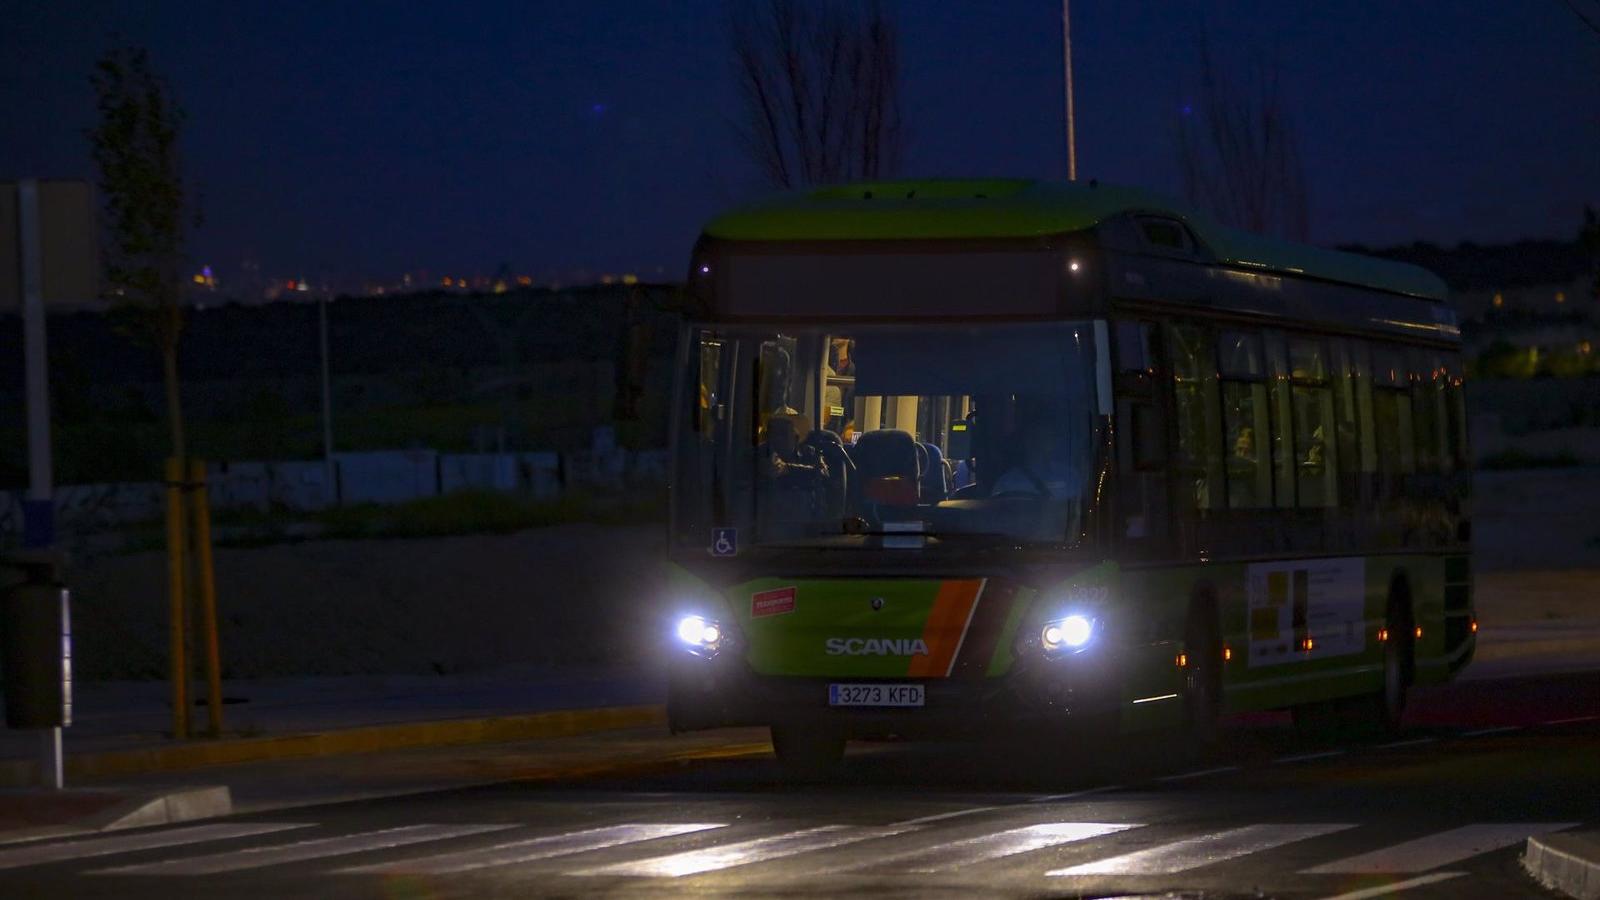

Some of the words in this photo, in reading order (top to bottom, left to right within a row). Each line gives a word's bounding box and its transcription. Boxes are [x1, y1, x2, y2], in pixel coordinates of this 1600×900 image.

[825, 638, 929, 657] SCANIA
[841, 687, 882, 704] 3273
[888, 687, 919, 704] KFD
